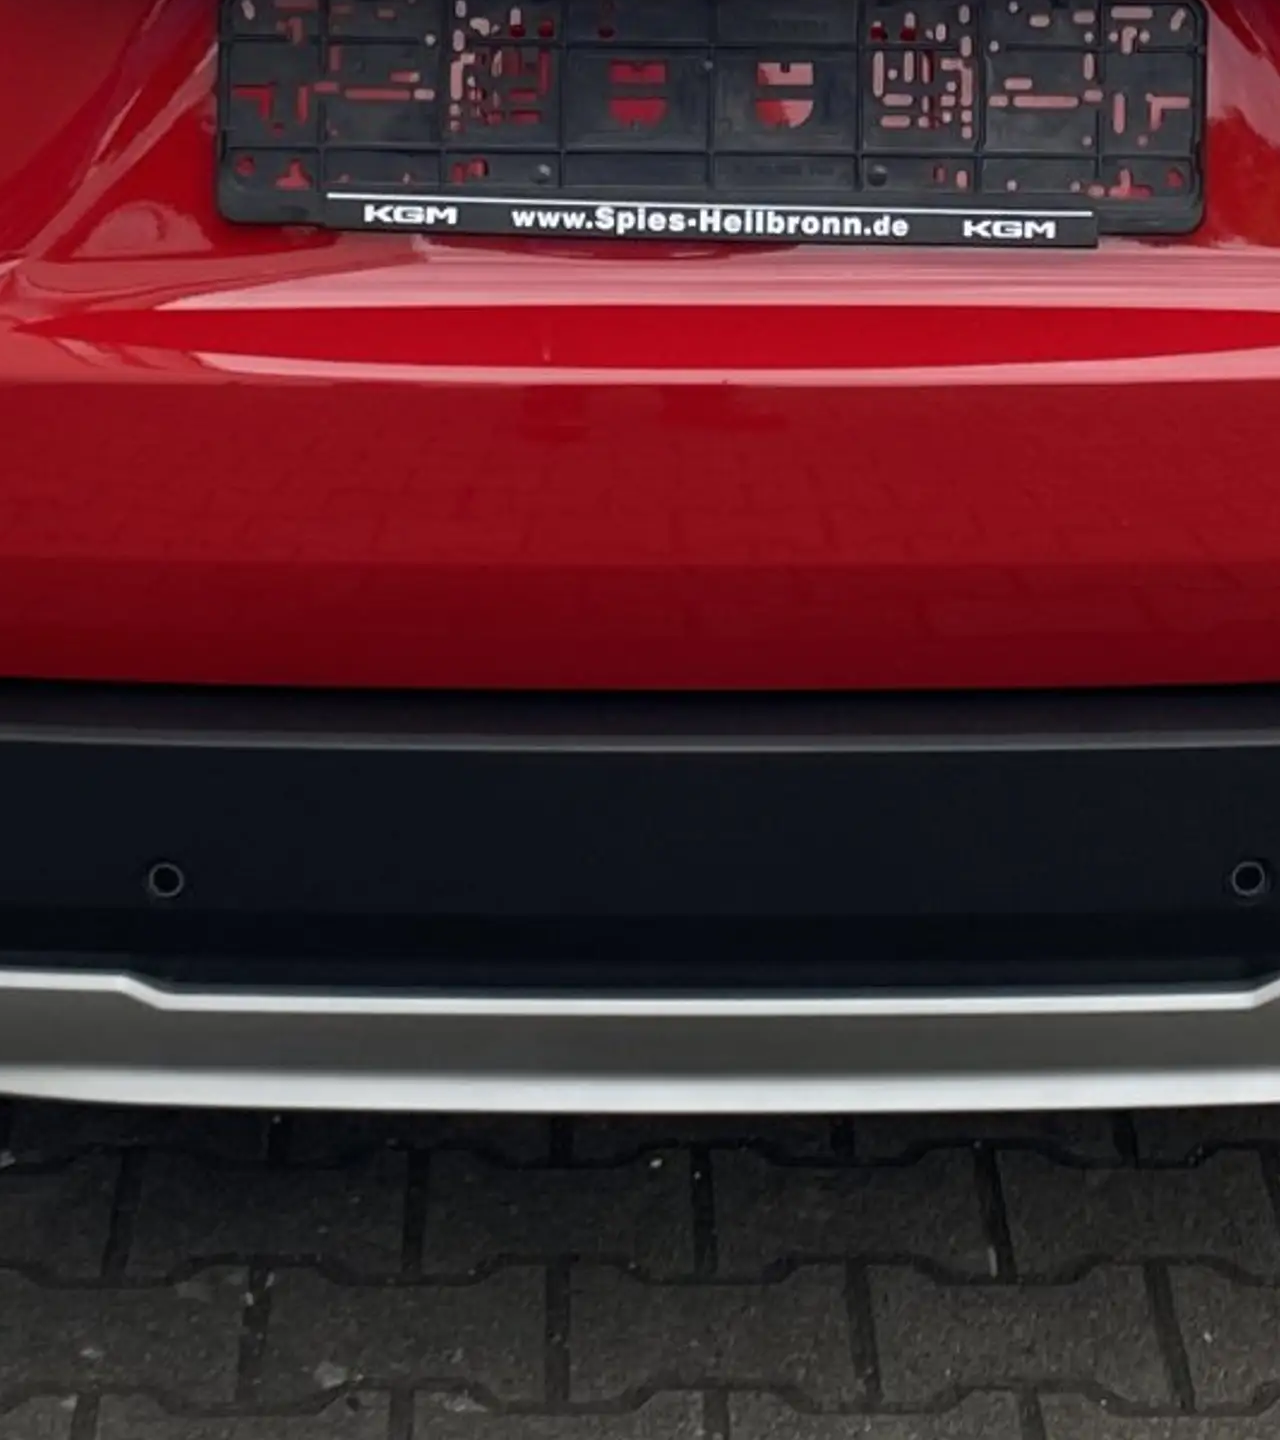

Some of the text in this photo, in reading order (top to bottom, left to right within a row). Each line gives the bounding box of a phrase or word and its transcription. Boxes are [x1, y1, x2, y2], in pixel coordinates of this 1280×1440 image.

[363, 204, 1057, 240] KGM www.Spies-Heilbronn.de KGM
